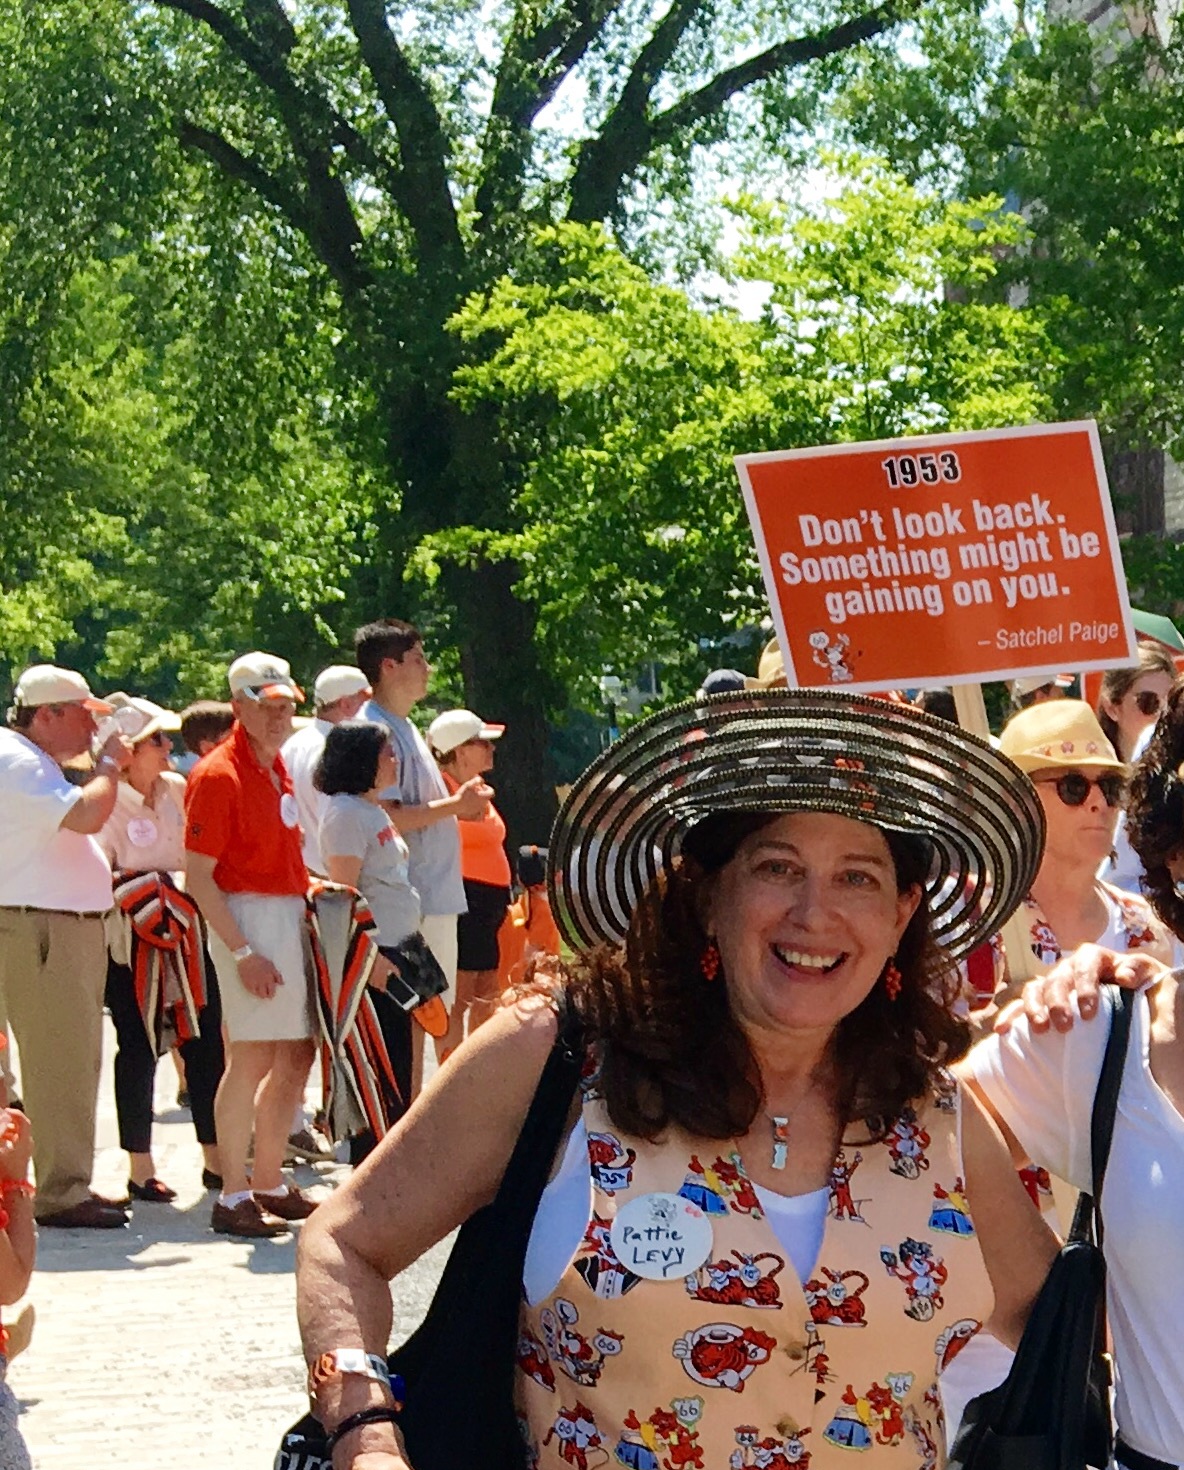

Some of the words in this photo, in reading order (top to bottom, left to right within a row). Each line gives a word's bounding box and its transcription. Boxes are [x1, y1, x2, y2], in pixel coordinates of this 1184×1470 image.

[882, 450, 961, 488] 1953
[799, 509, 887, 547] Don't
[892, 502, 966, 541] look
[972, 493, 1066, 532] back.
[780, 544, 951, 585] Something
[959, 531, 1053, 572] might
[1059, 527, 1100, 559] be
[825, 582, 944, 622] gaining
[953, 578, 993, 607] on
[1000, 572, 1070, 608] you.
[996, 624, 1063, 649] Satchel
[1069, 621, 1119, 643] Paige
[623, 1222, 683, 1244] Pattie
[633, 1247, 685, 1278] LEVY
[598, 1338, 616, 1351] 66
[679, 1404, 698, 1417] 66
